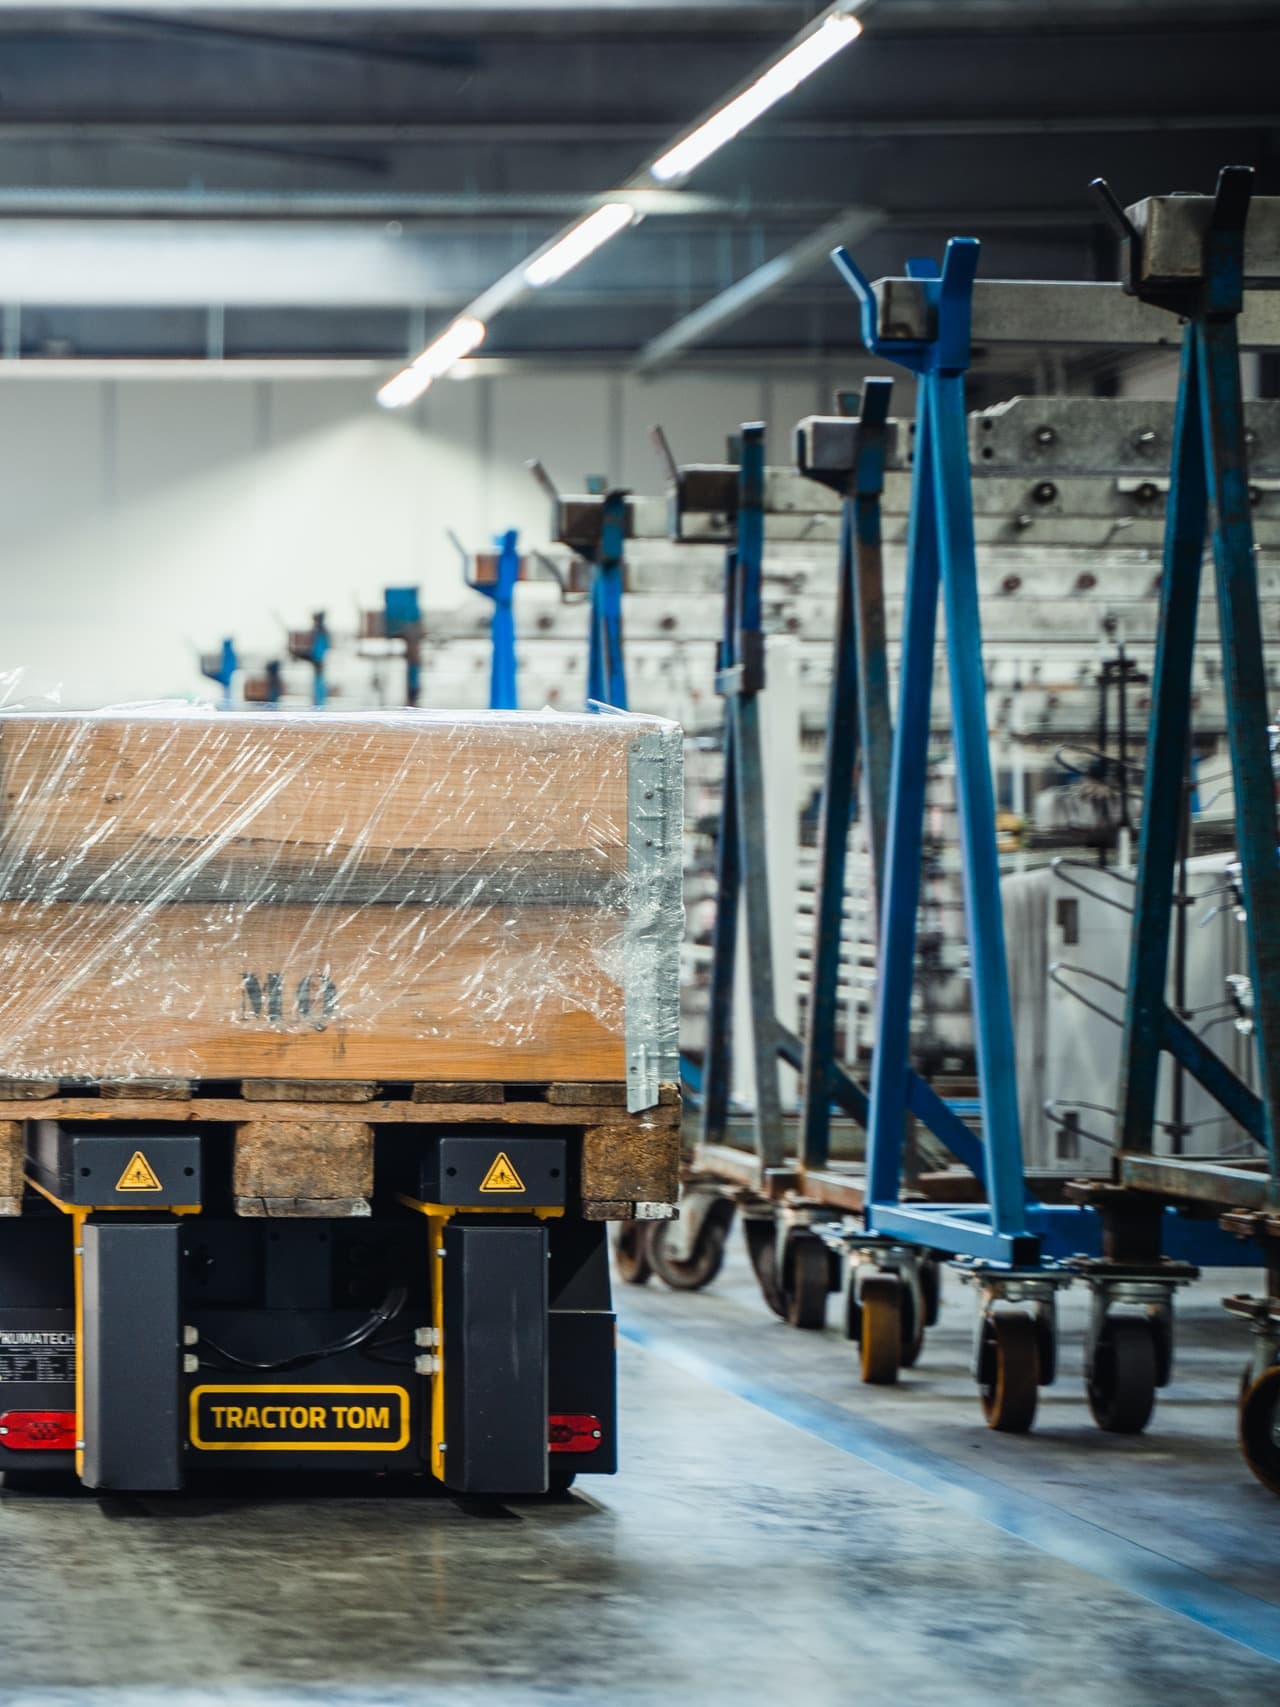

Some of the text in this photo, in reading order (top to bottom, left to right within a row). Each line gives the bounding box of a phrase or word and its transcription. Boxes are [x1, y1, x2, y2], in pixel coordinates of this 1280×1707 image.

[1, 1333, 75, 1345] KUMATECH
[210, 1406, 389, 1429] TRACTOR TOM
